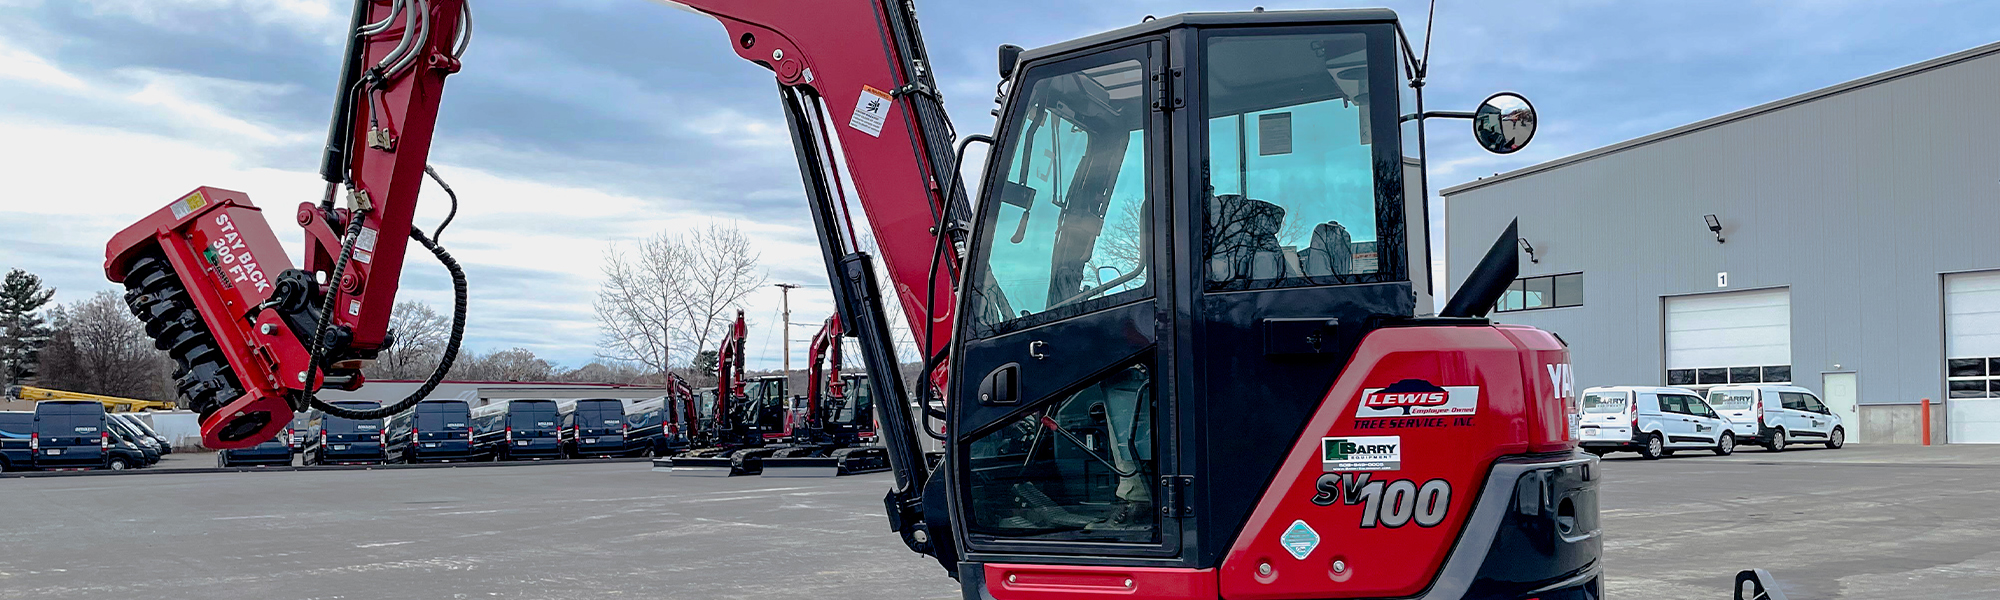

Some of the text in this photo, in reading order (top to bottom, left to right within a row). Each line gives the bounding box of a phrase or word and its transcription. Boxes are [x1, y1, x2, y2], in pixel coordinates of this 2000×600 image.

[215, 213, 246, 250] STAY
[238, 251, 270, 293] BACK
[213, 238, 235, 264] 300
[228, 264, 248, 283] FT
[1368, 392, 1445, 405] LEWIS
[1411, 407, 1450, 415] Employee
[1353, 417, 1476, 430] TREE SERVICE, INC.
[1339, 442, 1397, 455] BARRY
